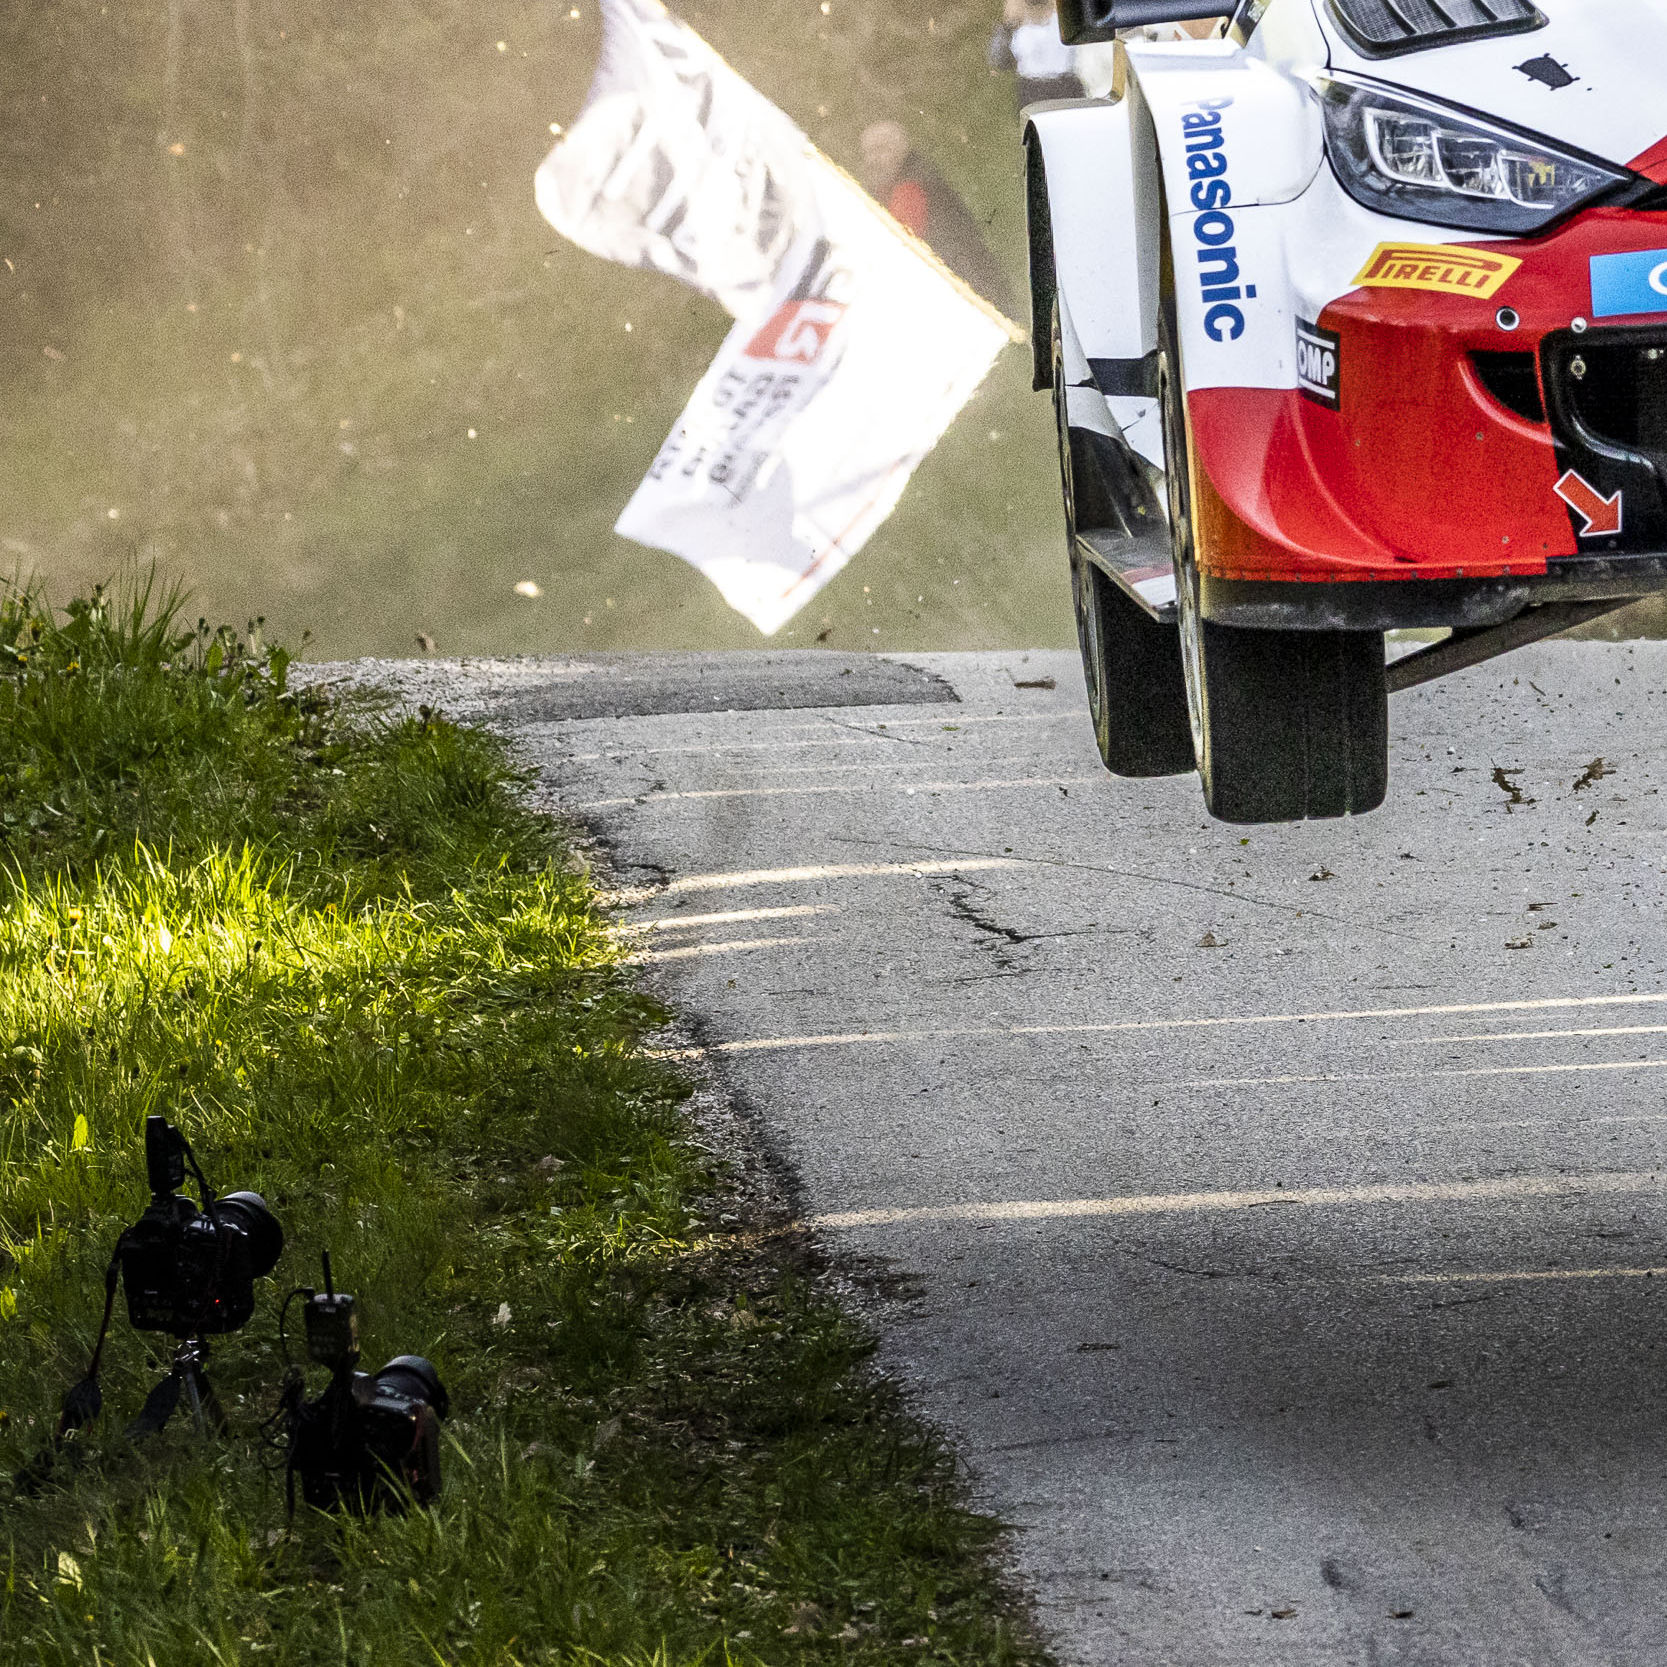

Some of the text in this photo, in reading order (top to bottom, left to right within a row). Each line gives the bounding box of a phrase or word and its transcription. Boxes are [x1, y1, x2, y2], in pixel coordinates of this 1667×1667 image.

[1178, 96, 1257, 342] Panasonic
[1364, 249, 1503, 289] PIRELLI
[1298, 339, 1336, 386] OMP
